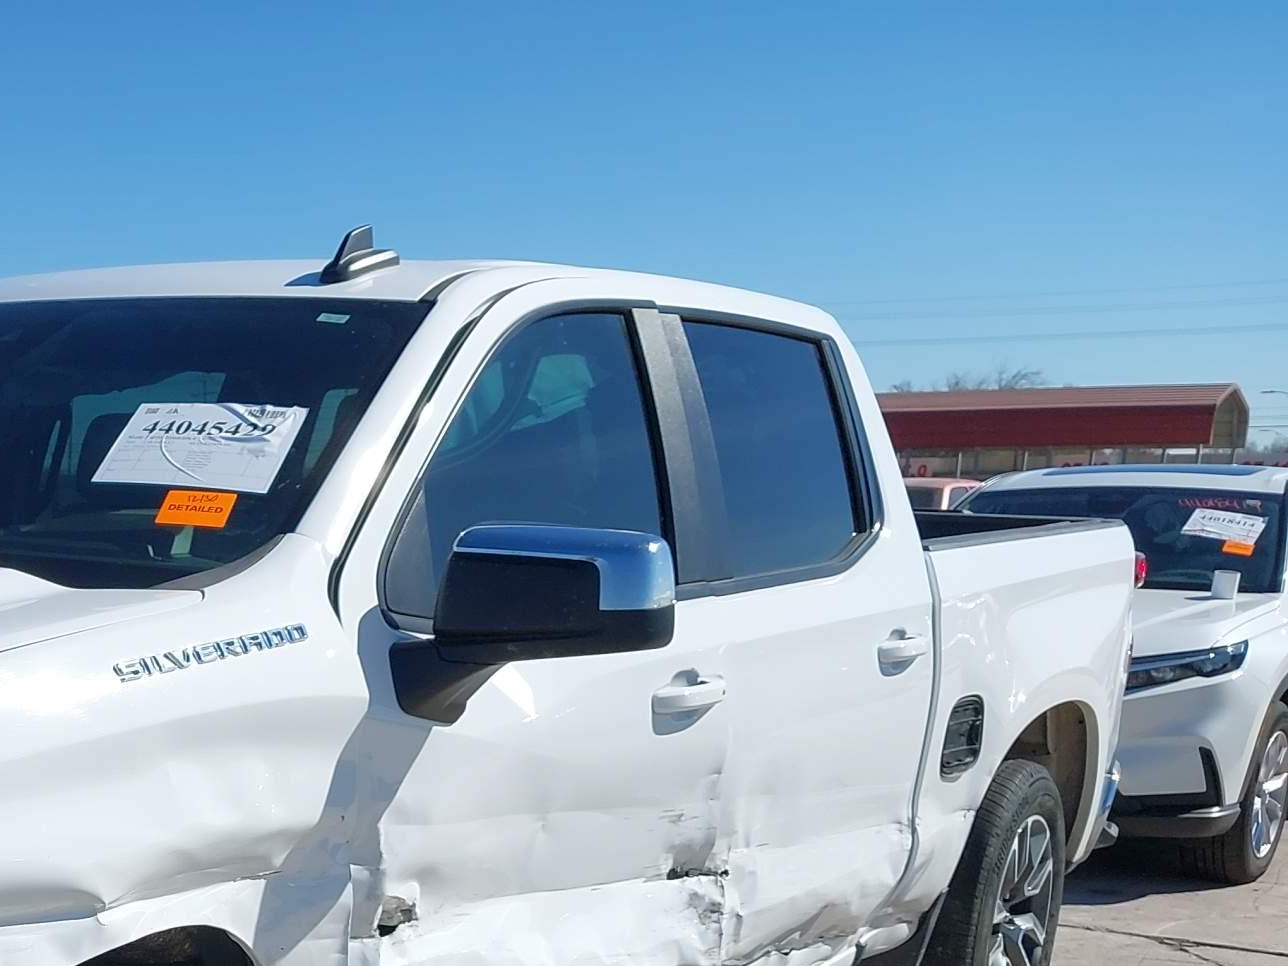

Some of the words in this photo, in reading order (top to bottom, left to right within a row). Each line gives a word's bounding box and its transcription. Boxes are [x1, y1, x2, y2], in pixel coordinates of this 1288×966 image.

[142, 419, 277, 436] 44045429
[168, 503, 224, 513] DETAILED
[112, 623, 309, 683] SILVERADO
